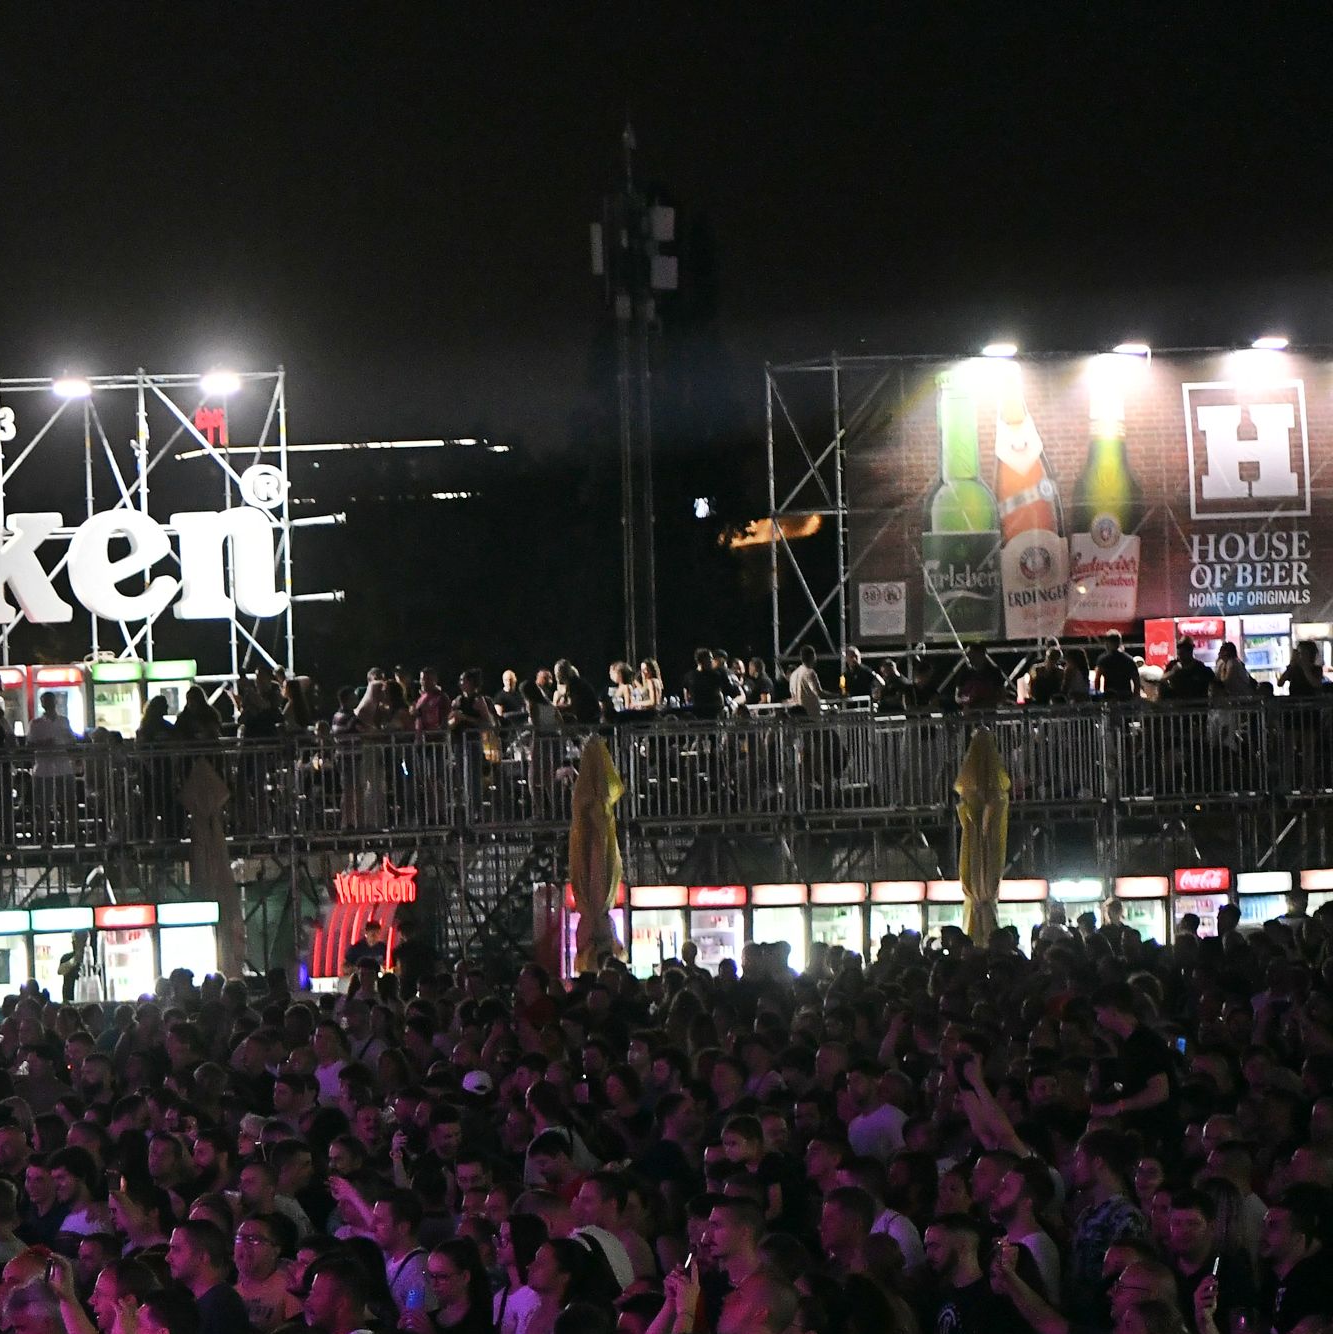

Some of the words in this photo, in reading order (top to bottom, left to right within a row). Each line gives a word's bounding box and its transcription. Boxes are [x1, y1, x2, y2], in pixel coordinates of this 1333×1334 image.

[1189, 530, 1312, 564] HOUSE
[1190, 562, 1231, 590] OF
[1234, 561, 1311, 588] BEER
[1189, 591, 1224, 609] HOME
[1227, 591, 1244, 606] OF
[1246, 588, 1311, 606] ORIGINALS
